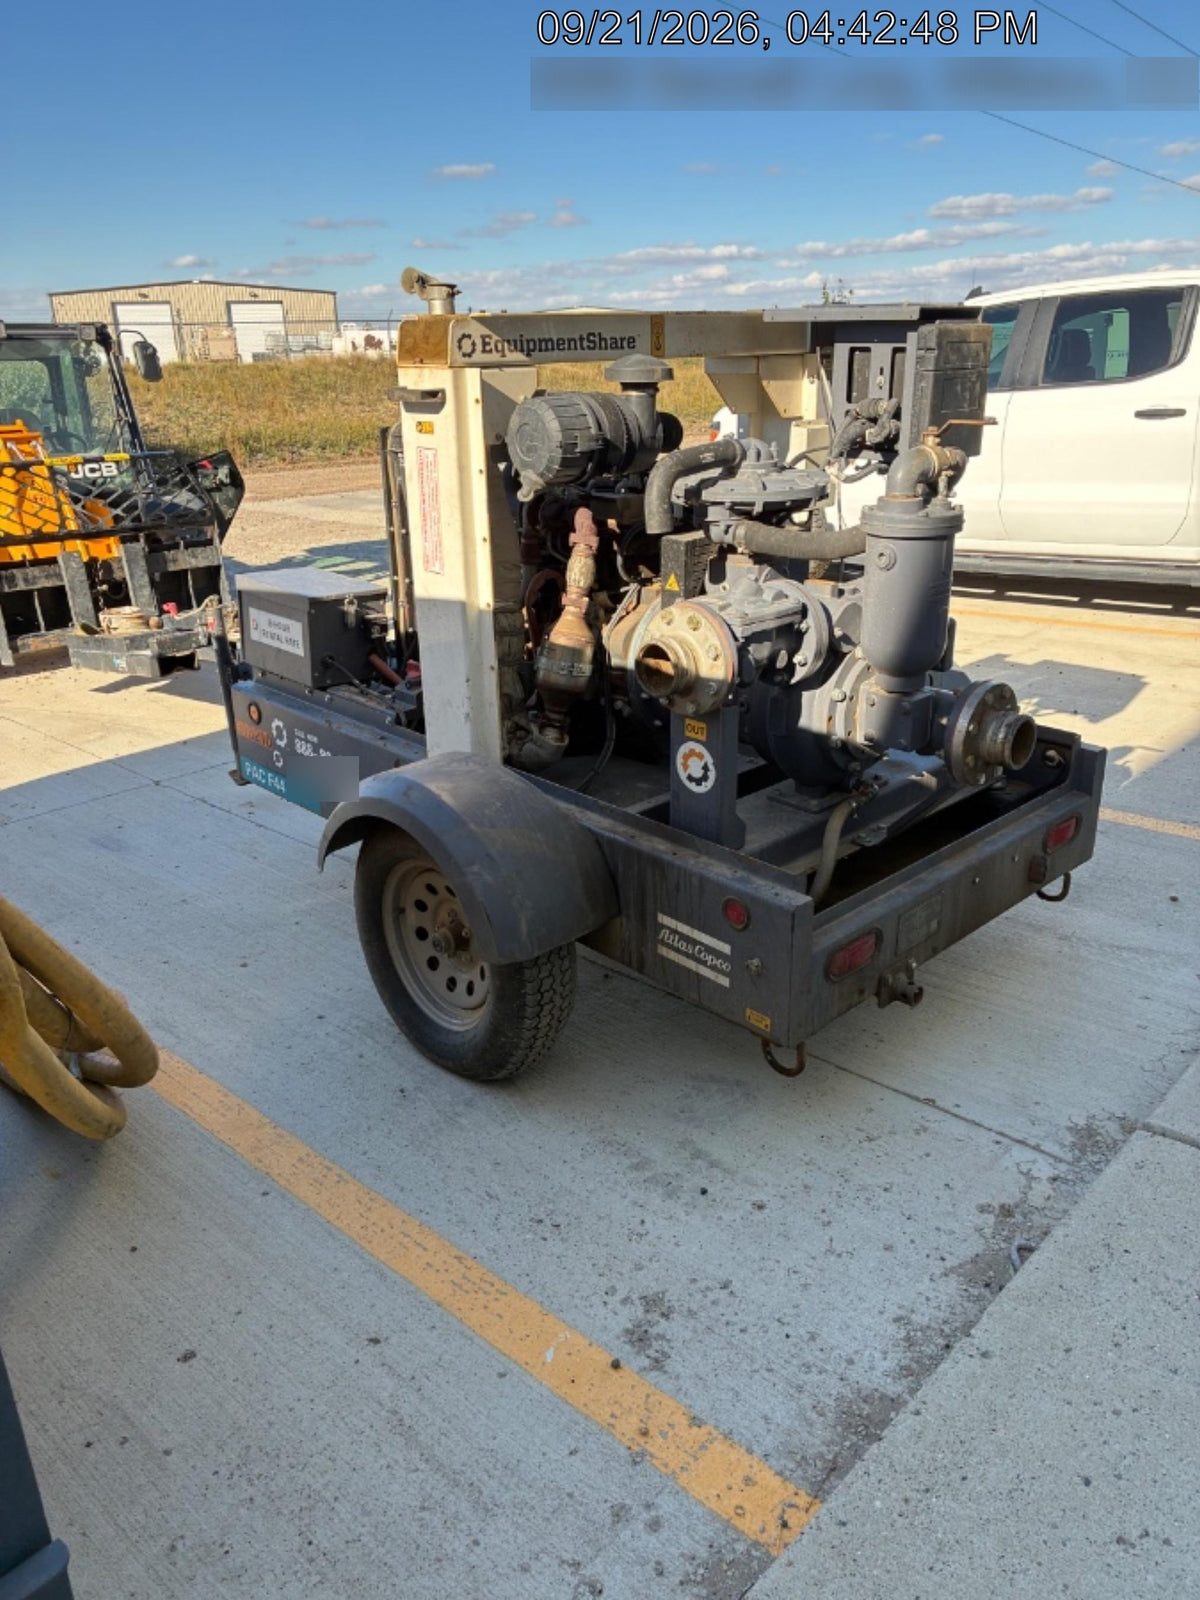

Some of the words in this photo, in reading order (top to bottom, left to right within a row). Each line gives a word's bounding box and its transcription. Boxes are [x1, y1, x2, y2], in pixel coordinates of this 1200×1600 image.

[479, 332, 637, 358] EquipmentShare
[70, 462, 118, 479] JCB
[686, 722, 705, 737] OUT
[658, 928, 694, 954] Atlas
[694, 944, 732, 973] Copco
